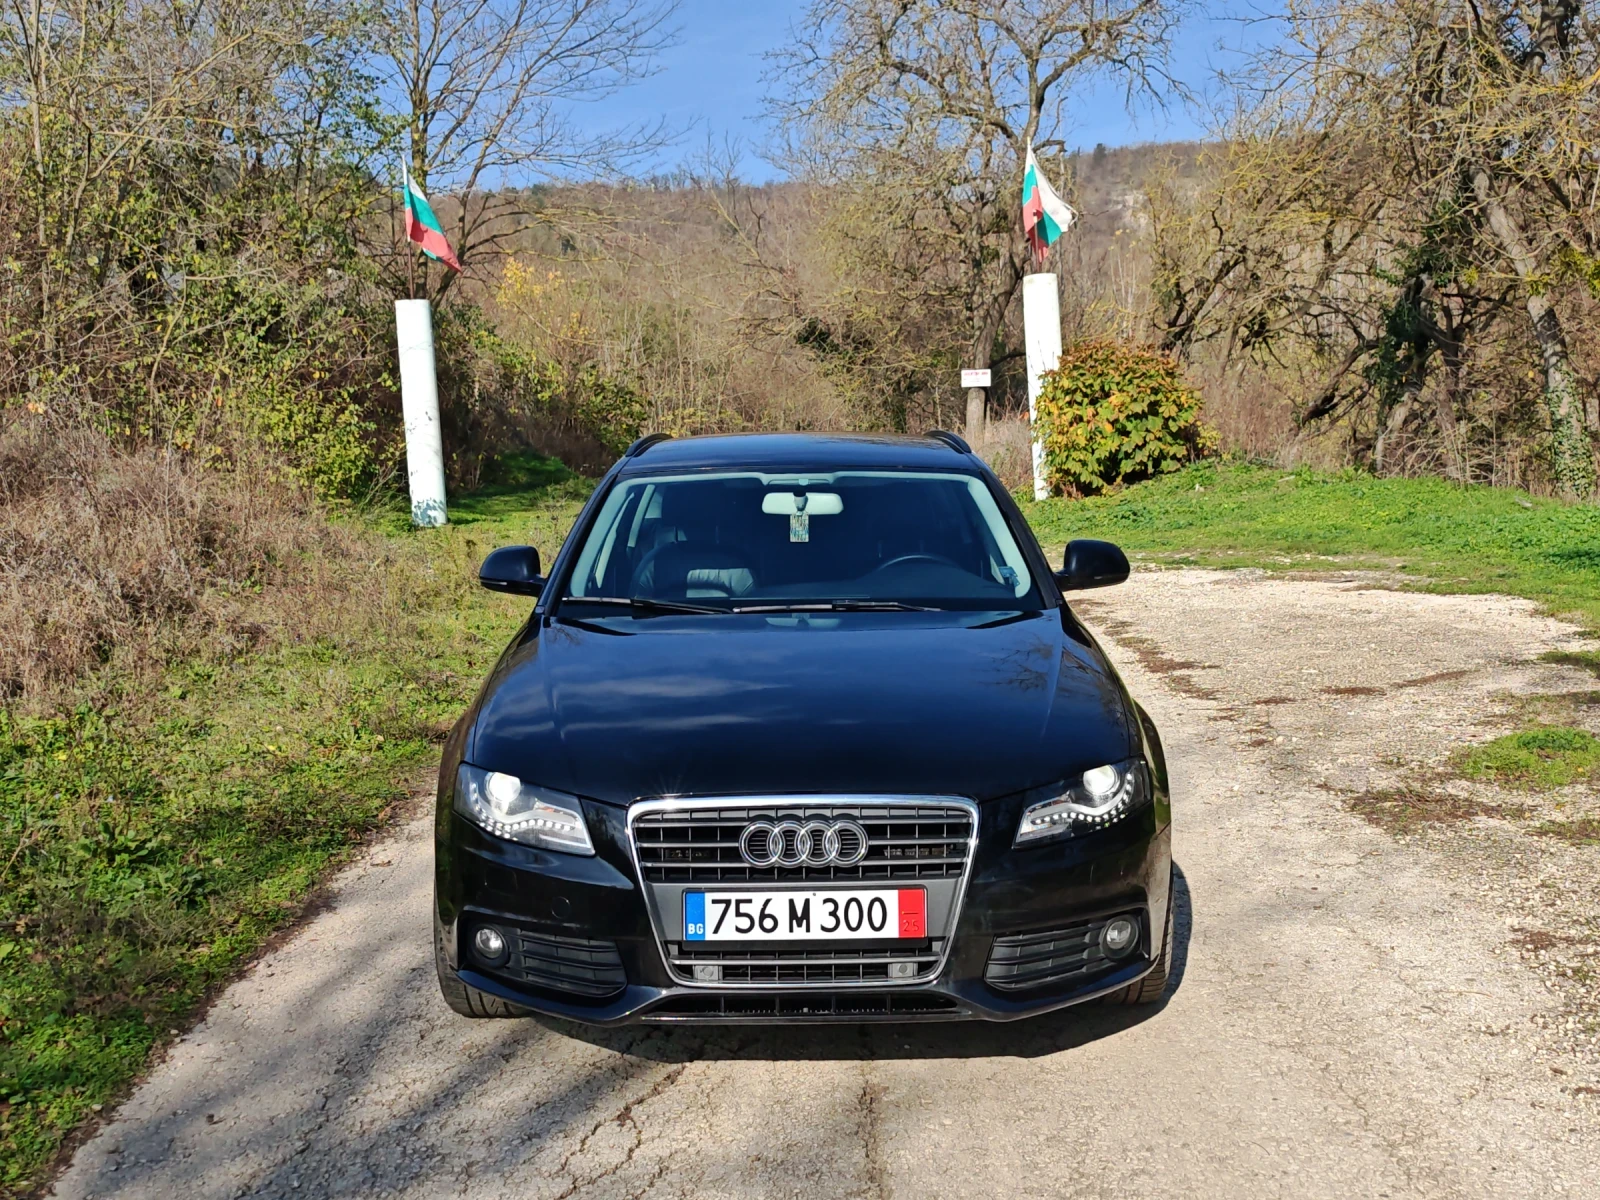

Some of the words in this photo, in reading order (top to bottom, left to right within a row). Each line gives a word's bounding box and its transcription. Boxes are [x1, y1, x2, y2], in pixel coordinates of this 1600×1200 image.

[711, 898, 779, 935] 756
[788, 898, 811, 934] M
[820, 896, 888, 933] 300
[687, 922, 704, 935] BG
[902, 919, 920, 932] 25
